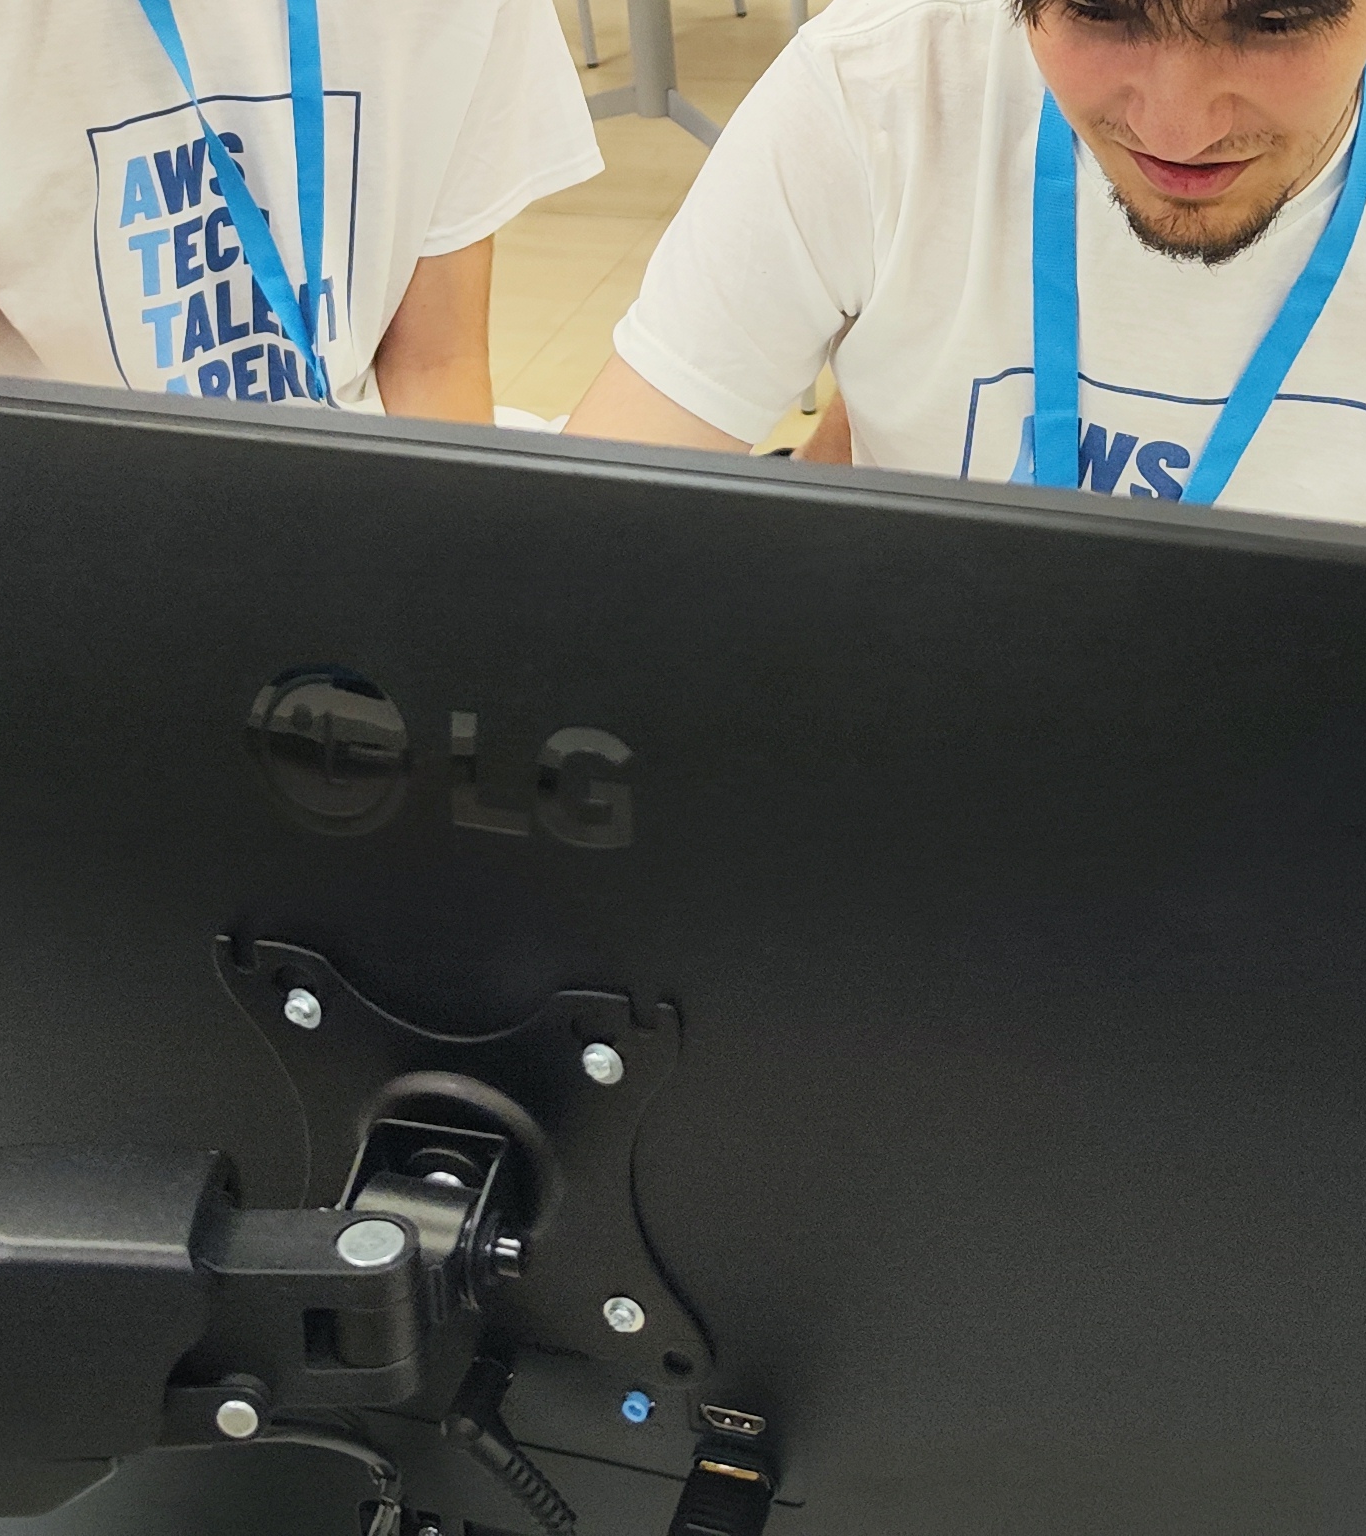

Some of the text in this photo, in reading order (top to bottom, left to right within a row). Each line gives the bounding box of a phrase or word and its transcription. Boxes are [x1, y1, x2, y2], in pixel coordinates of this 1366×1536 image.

[119, 131, 248, 229] AWS
[128, 206, 270, 298] TEC
[451, 710, 633, 850] LG
